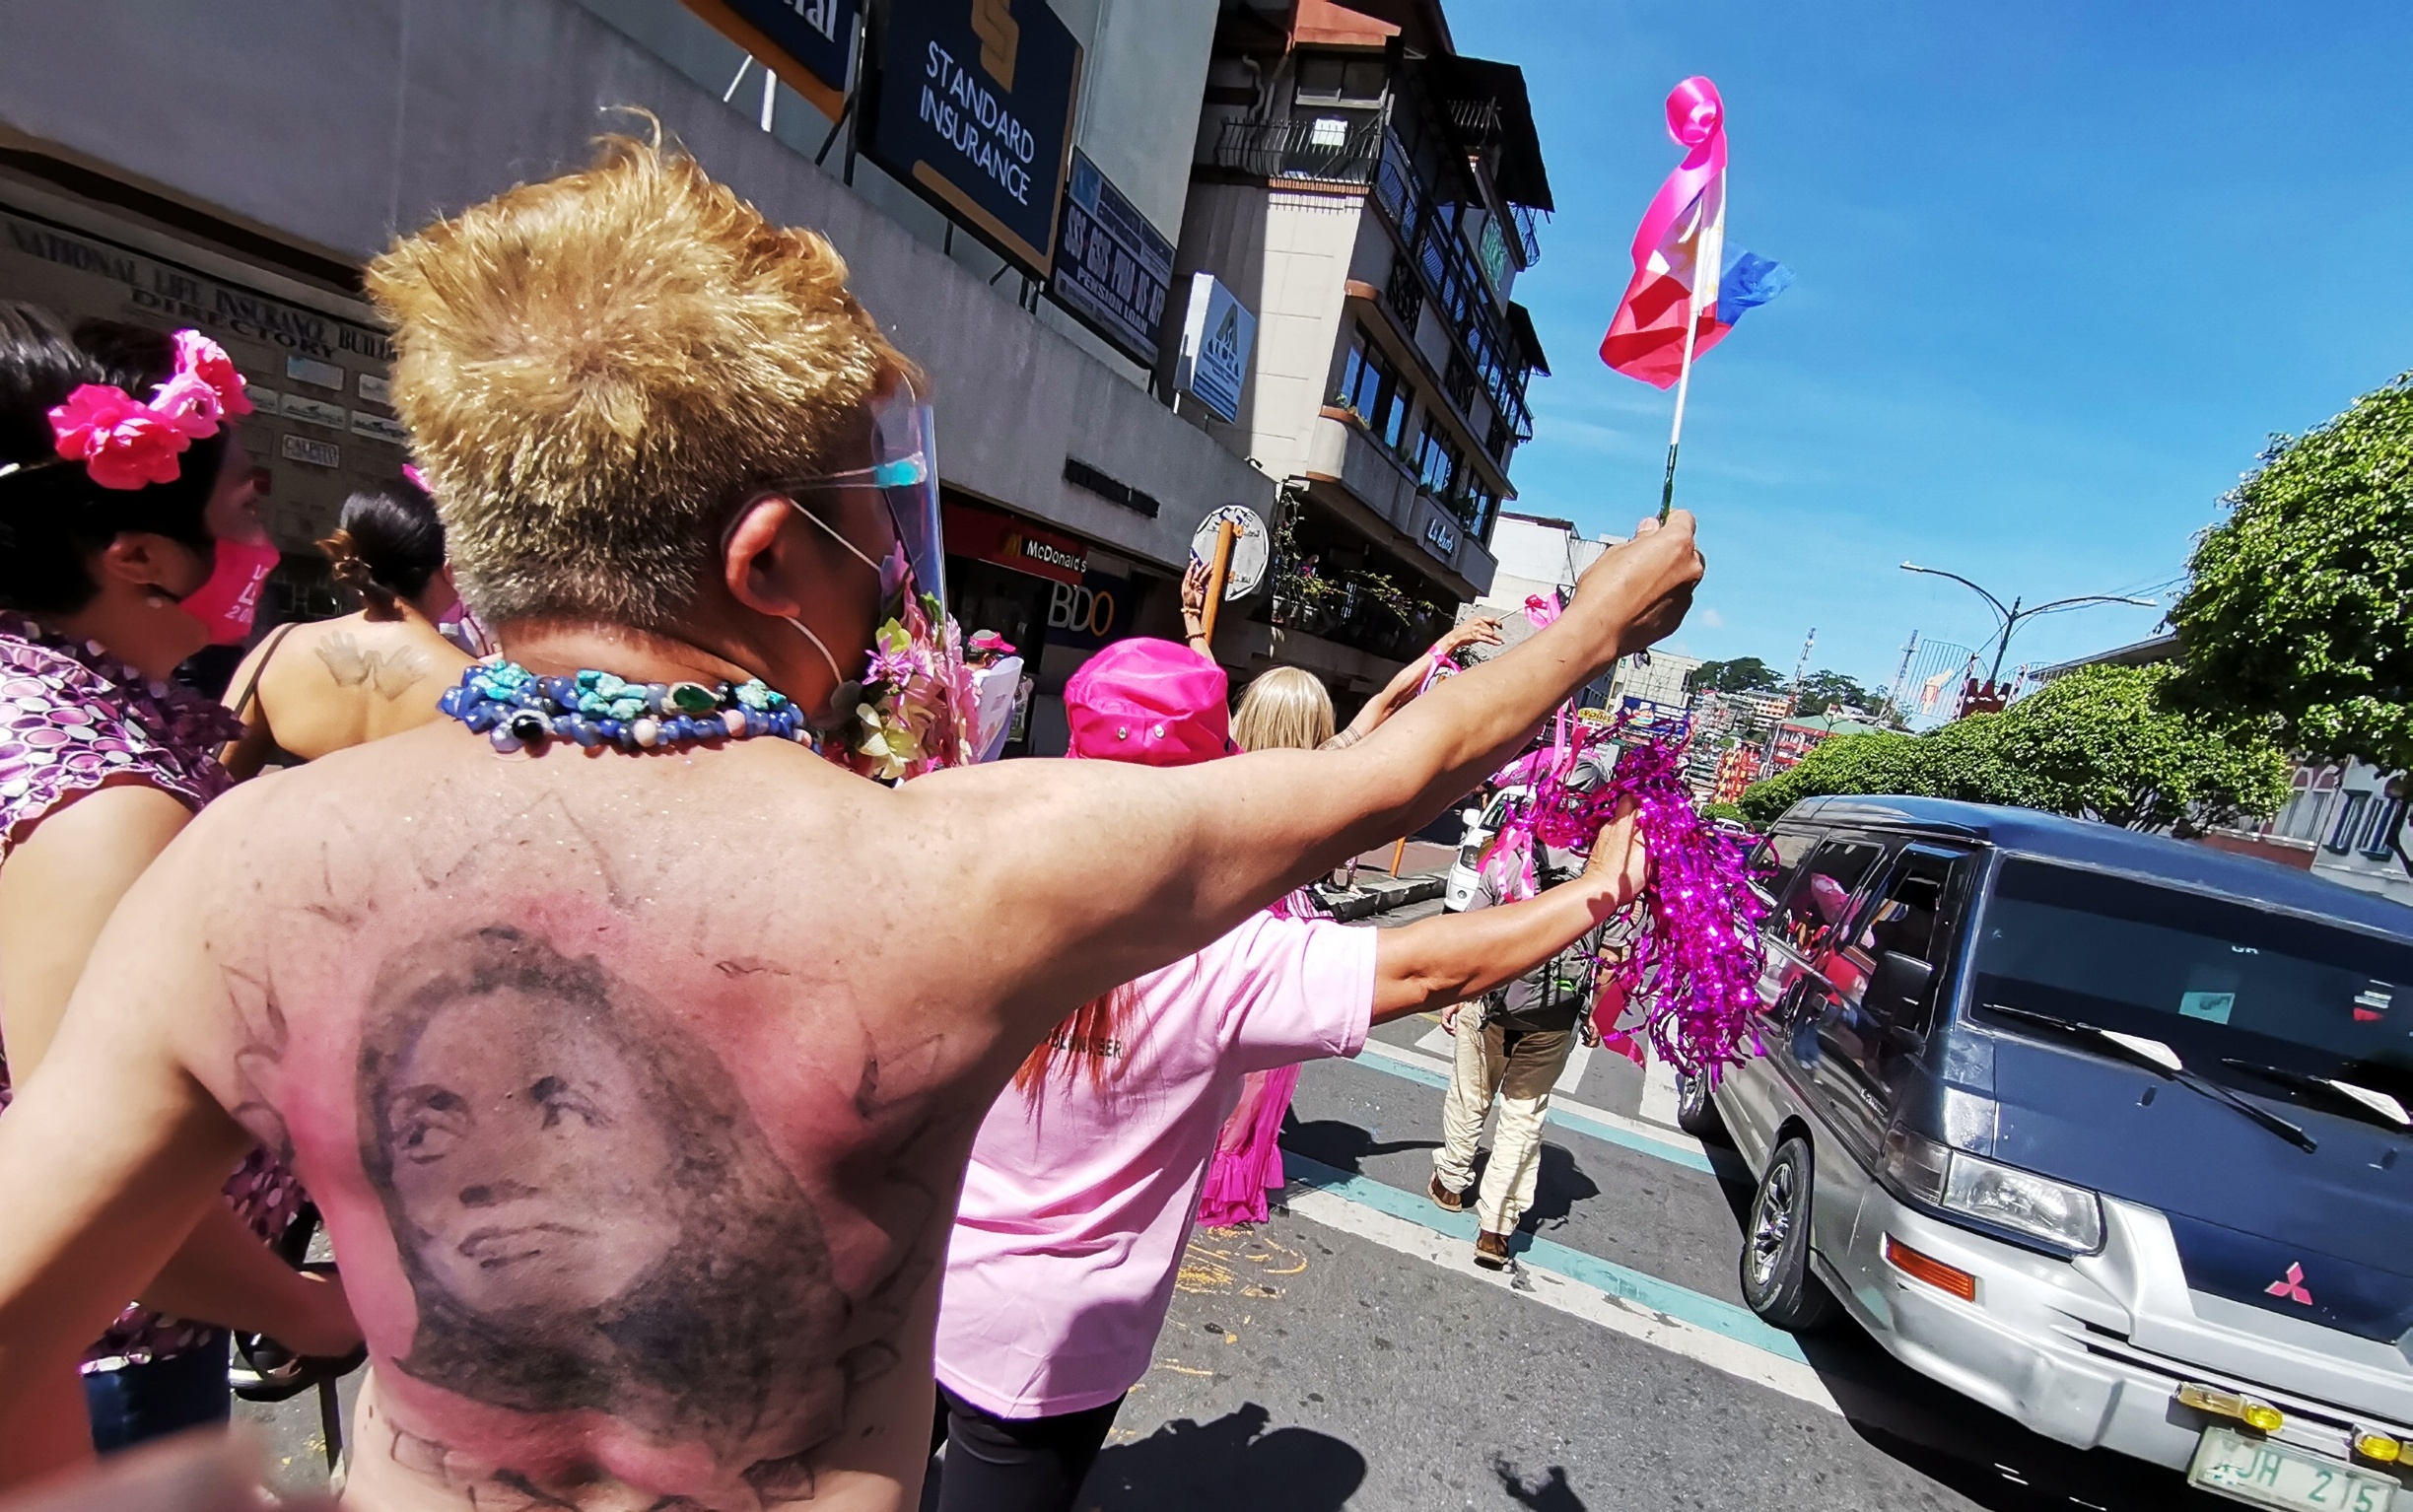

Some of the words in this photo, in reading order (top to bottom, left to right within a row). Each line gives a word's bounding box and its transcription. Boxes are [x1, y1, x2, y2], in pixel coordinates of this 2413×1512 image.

[926, 39, 1035, 164] STANDARD
[920, 84, 1031, 206] INSURANCE
[1065, 204, 1087, 261] SSS
[8, 221, 140, 287] NATIONAL
[154, 268, 200, 305] LIFE
[215, 288, 326, 342] INSURANCE
[1077, 264, 1124, 314] PENSION
[1124, 304, 1148, 335] LOAN
[132, 287, 336, 358] DIRECTORY
[1048, 581, 1115, 637] BDO
[2308, 1469, 2379, 1512] 215
